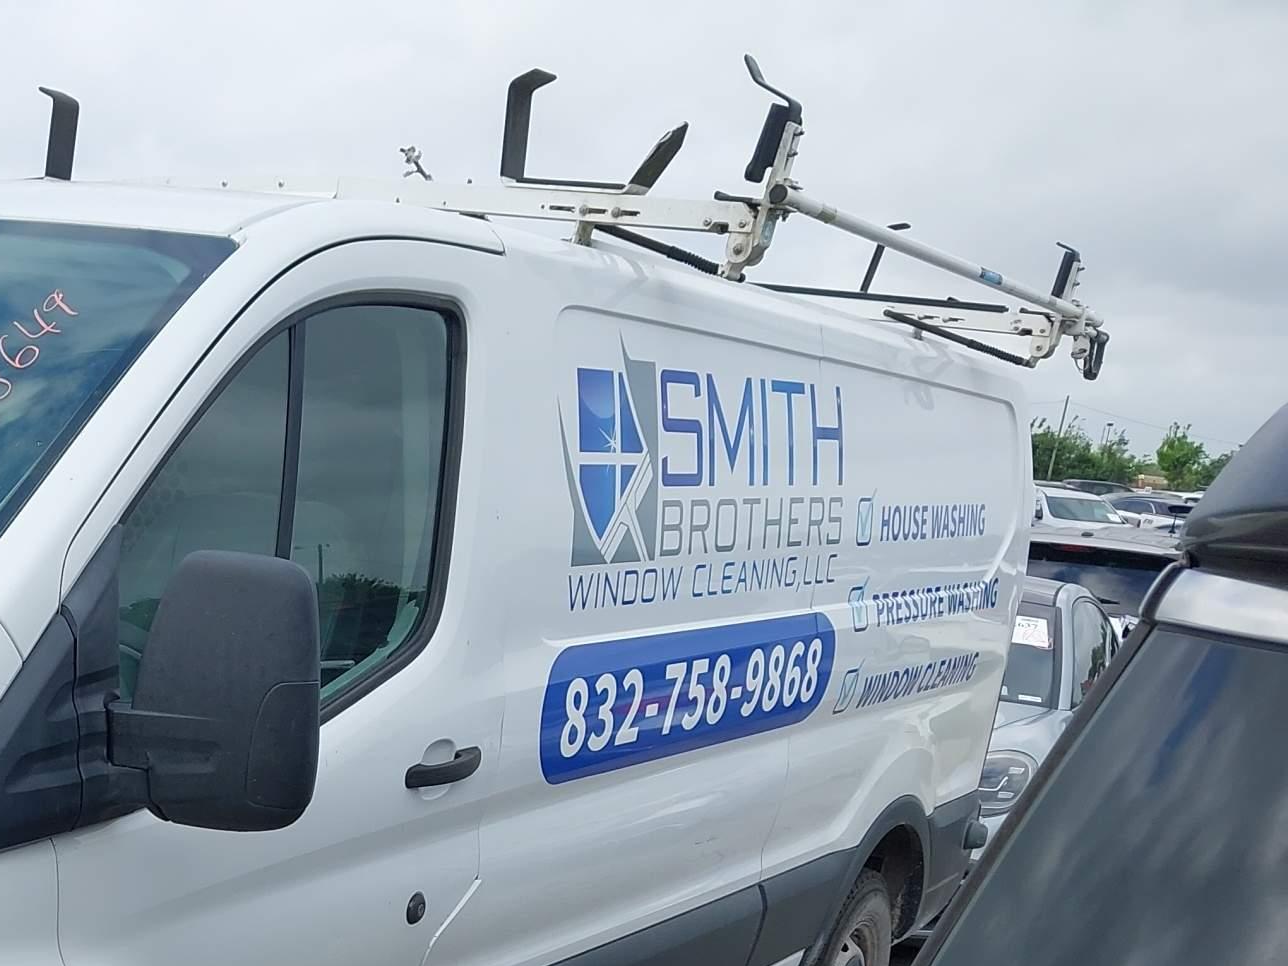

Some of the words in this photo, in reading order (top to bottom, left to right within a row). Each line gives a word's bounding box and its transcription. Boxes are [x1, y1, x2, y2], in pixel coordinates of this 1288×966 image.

[660, 369, 844, 487] SMITH
[659, 497, 843, 557] BROTHERS
[879, 504, 929, 542] HOUSE
[931, 503, 986, 539] WASHING
[568, 566, 684, 612] WINDOW
[872, 586, 945, 628] PRESSURE
[944, 577, 1000, 616] WASHING
[559, 637, 823, 759] 832-758-9868
[856, 664, 924, 709] WINDOW
[918, 652, 979, 694] CLEANING
